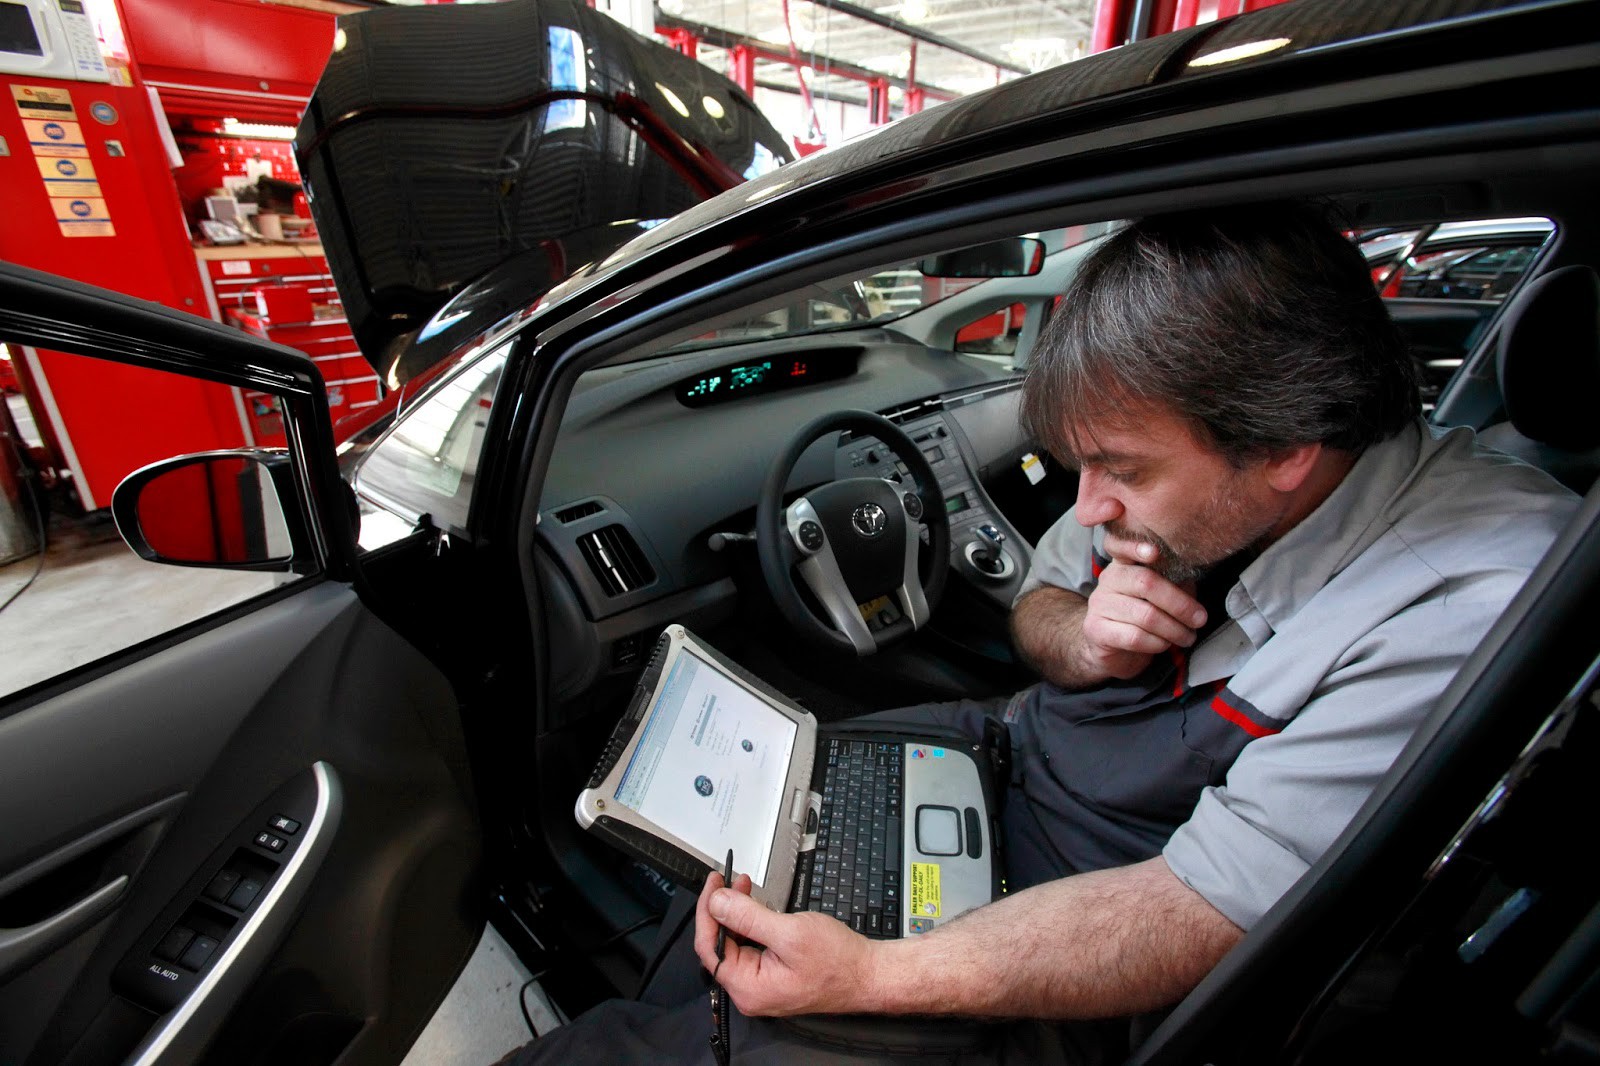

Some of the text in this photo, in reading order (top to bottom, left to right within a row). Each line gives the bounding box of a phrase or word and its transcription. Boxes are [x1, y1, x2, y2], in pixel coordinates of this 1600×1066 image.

[633, 861, 676, 897] PRIU
[794, 873, 806, 908] Panasonic
[149, 964, 179, 981] ALL AUTO
